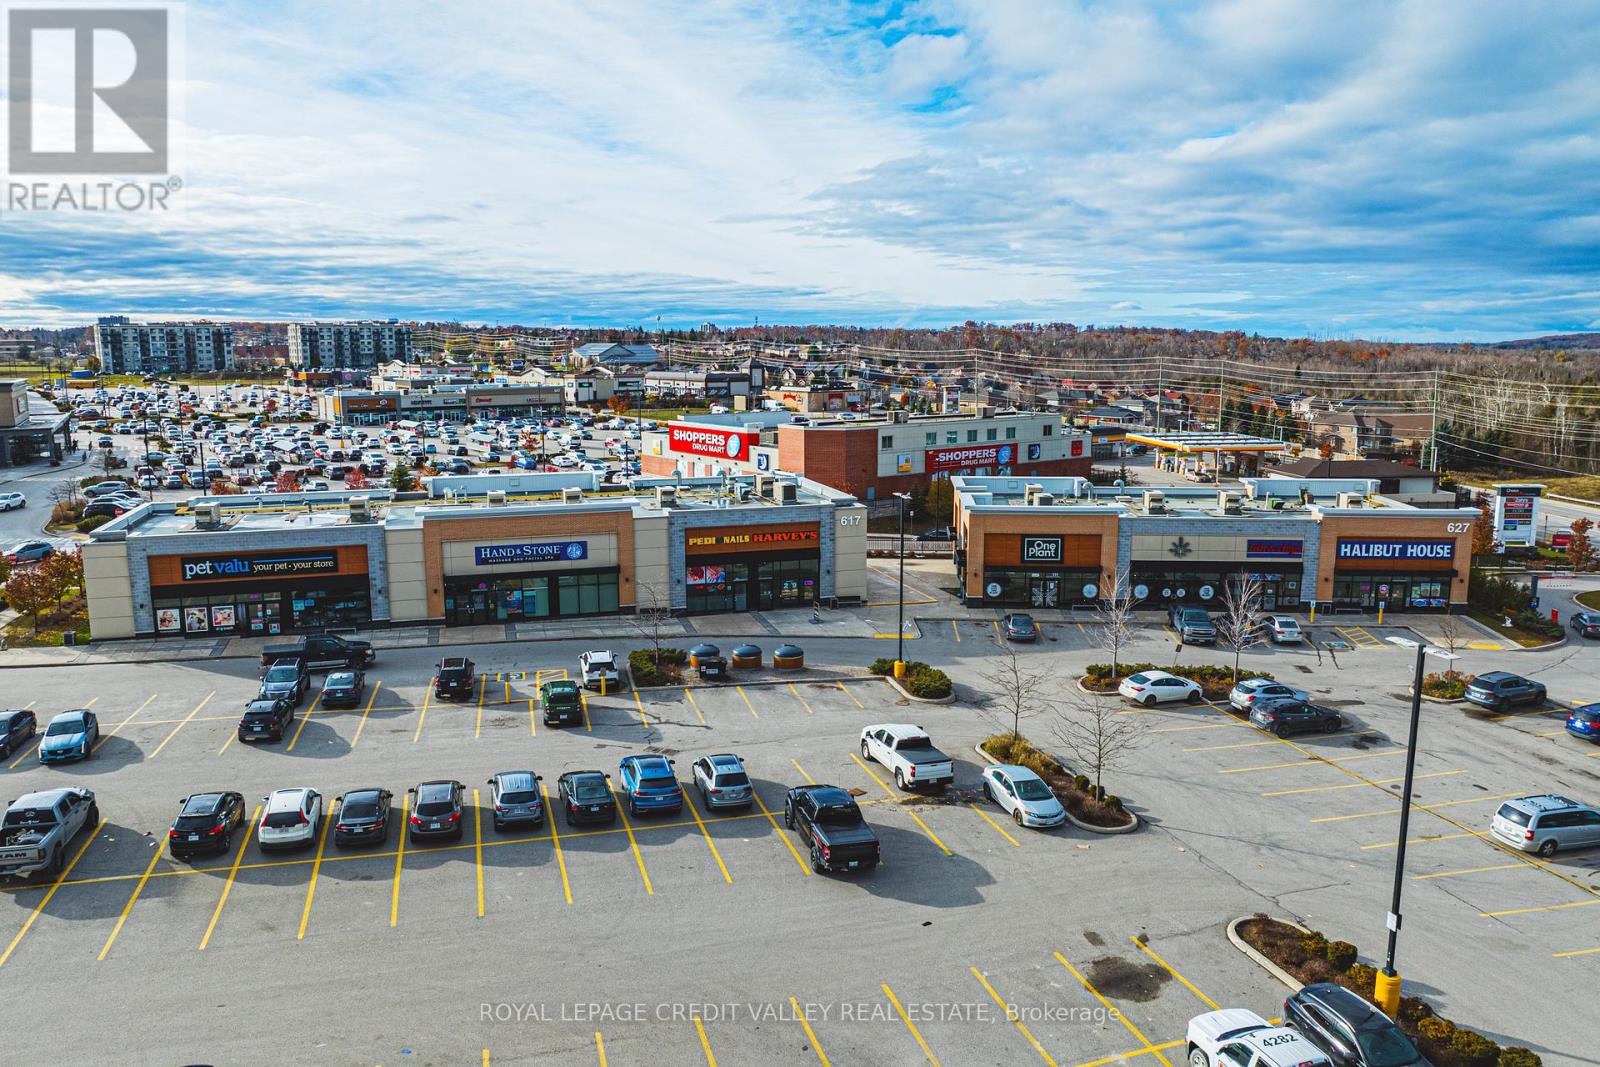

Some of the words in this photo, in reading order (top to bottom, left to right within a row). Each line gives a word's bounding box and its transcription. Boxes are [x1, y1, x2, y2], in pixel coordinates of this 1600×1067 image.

[673, 429, 726, 446] SHOPPERS
[692, 443, 708, 451] DRUG
[708, 445, 726, 453] MART
[938, 448, 997, 462] SHOPPERS
[960, 459, 978, 467] DRUG
[978, 457, 997, 465] MART
[840, 515, 862, 526] 617
[1447, 522, 1470, 533] 627
[688, 537, 716, 546] PEDI
[723, 535, 750, 544] NAILS
[753, 531, 818, 542] HARVEY'S
[1034, 540, 1057, 550] One
[481, 548, 515, 558] HAND
[523, 545, 561, 555] STONE
[1028, 548, 1056, 557] Plant
[1340, 544, 1402, 557] HALIBUT
[1406, 544, 1452, 557] HOUSE
[184, 560, 213, 579] pet
[213, 558, 250, 574] valu
[253, 563, 272, 573] your
[274, 562, 288, 572] pet
[292, 561, 313, 571] your
[313, 560, 334, 568] store
[1262, 1033, 1299, 1047] 4282
